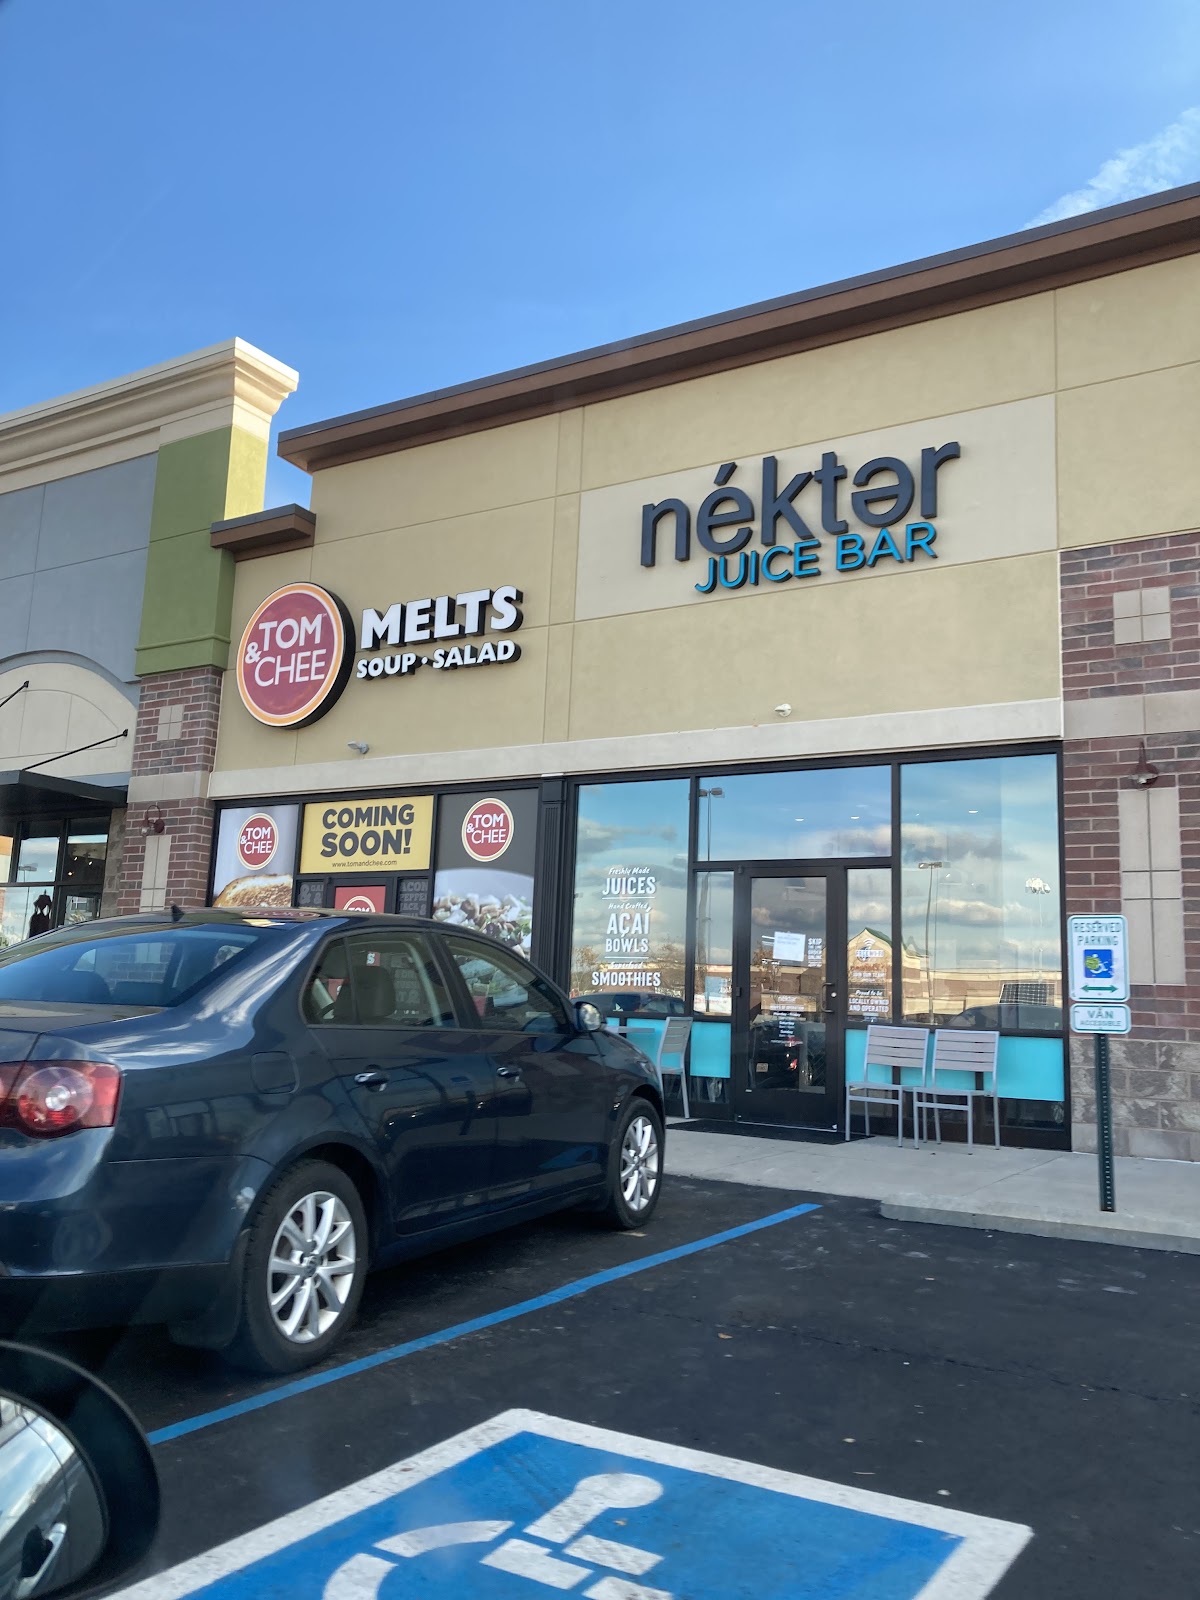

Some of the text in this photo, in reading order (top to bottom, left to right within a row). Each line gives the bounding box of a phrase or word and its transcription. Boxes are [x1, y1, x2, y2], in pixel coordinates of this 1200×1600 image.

[695, 521, 938, 594] JUICE BAR
[361, 585, 521, 650] MELTS
[258, 613, 324, 651] TOM
[245, 641, 327, 687] & CHEE
[356, 652, 417, 680] SOUP
[433, 640, 519, 669] SALAD
[322, 803, 415, 829] COMING
[473, 813, 504, 828] TOM
[246, 827, 271, 840] TOM
[466, 823, 507, 844] & CHEE
[240, 835, 272, 854] & CHEE
[320, 828, 412, 858] SOON!
[332, 860, 398, 868] www.tomandchee.com
[608, 867, 650, 875] Freshly Made
[602, 876, 656, 895] JUICES
[625, 902, 648, 910] Crafted
[1073, 922, 1122, 933] RESERVED
[605, 938, 649, 953] BOWLS
[1077, 935, 1119, 946] PARKING
[591, 971, 661, 987] SMOOTHIES
[849, 997, 889, 1006] LOCALLY OWNED
[861, 1005, 890, 1013] OPERATED
[1087, 1010, 1114, 1019] VAN
